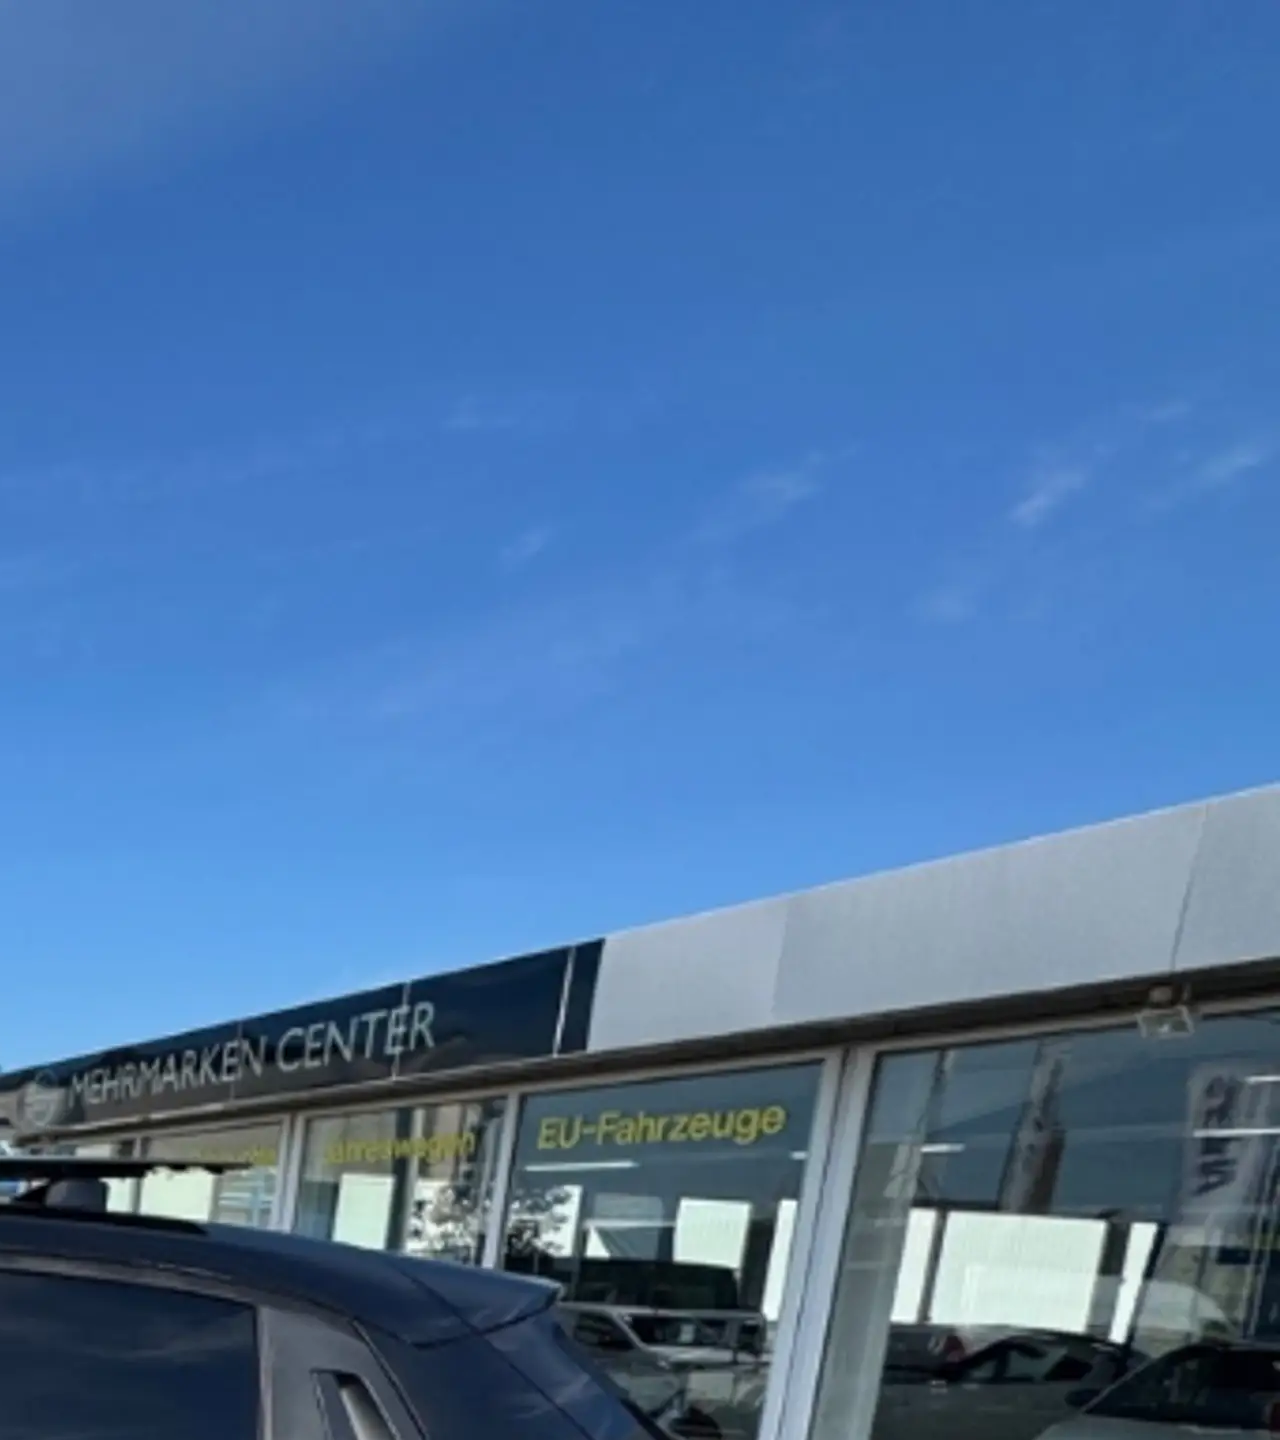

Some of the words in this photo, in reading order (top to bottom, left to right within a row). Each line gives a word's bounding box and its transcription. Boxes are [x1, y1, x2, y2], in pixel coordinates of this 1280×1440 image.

[68, 1034, 267, 1107] MEHRMARKEN
[276, 1001, 436, 1073] CENTER
[537, 1105, 787, 1150] EU-Fahrzeuge
